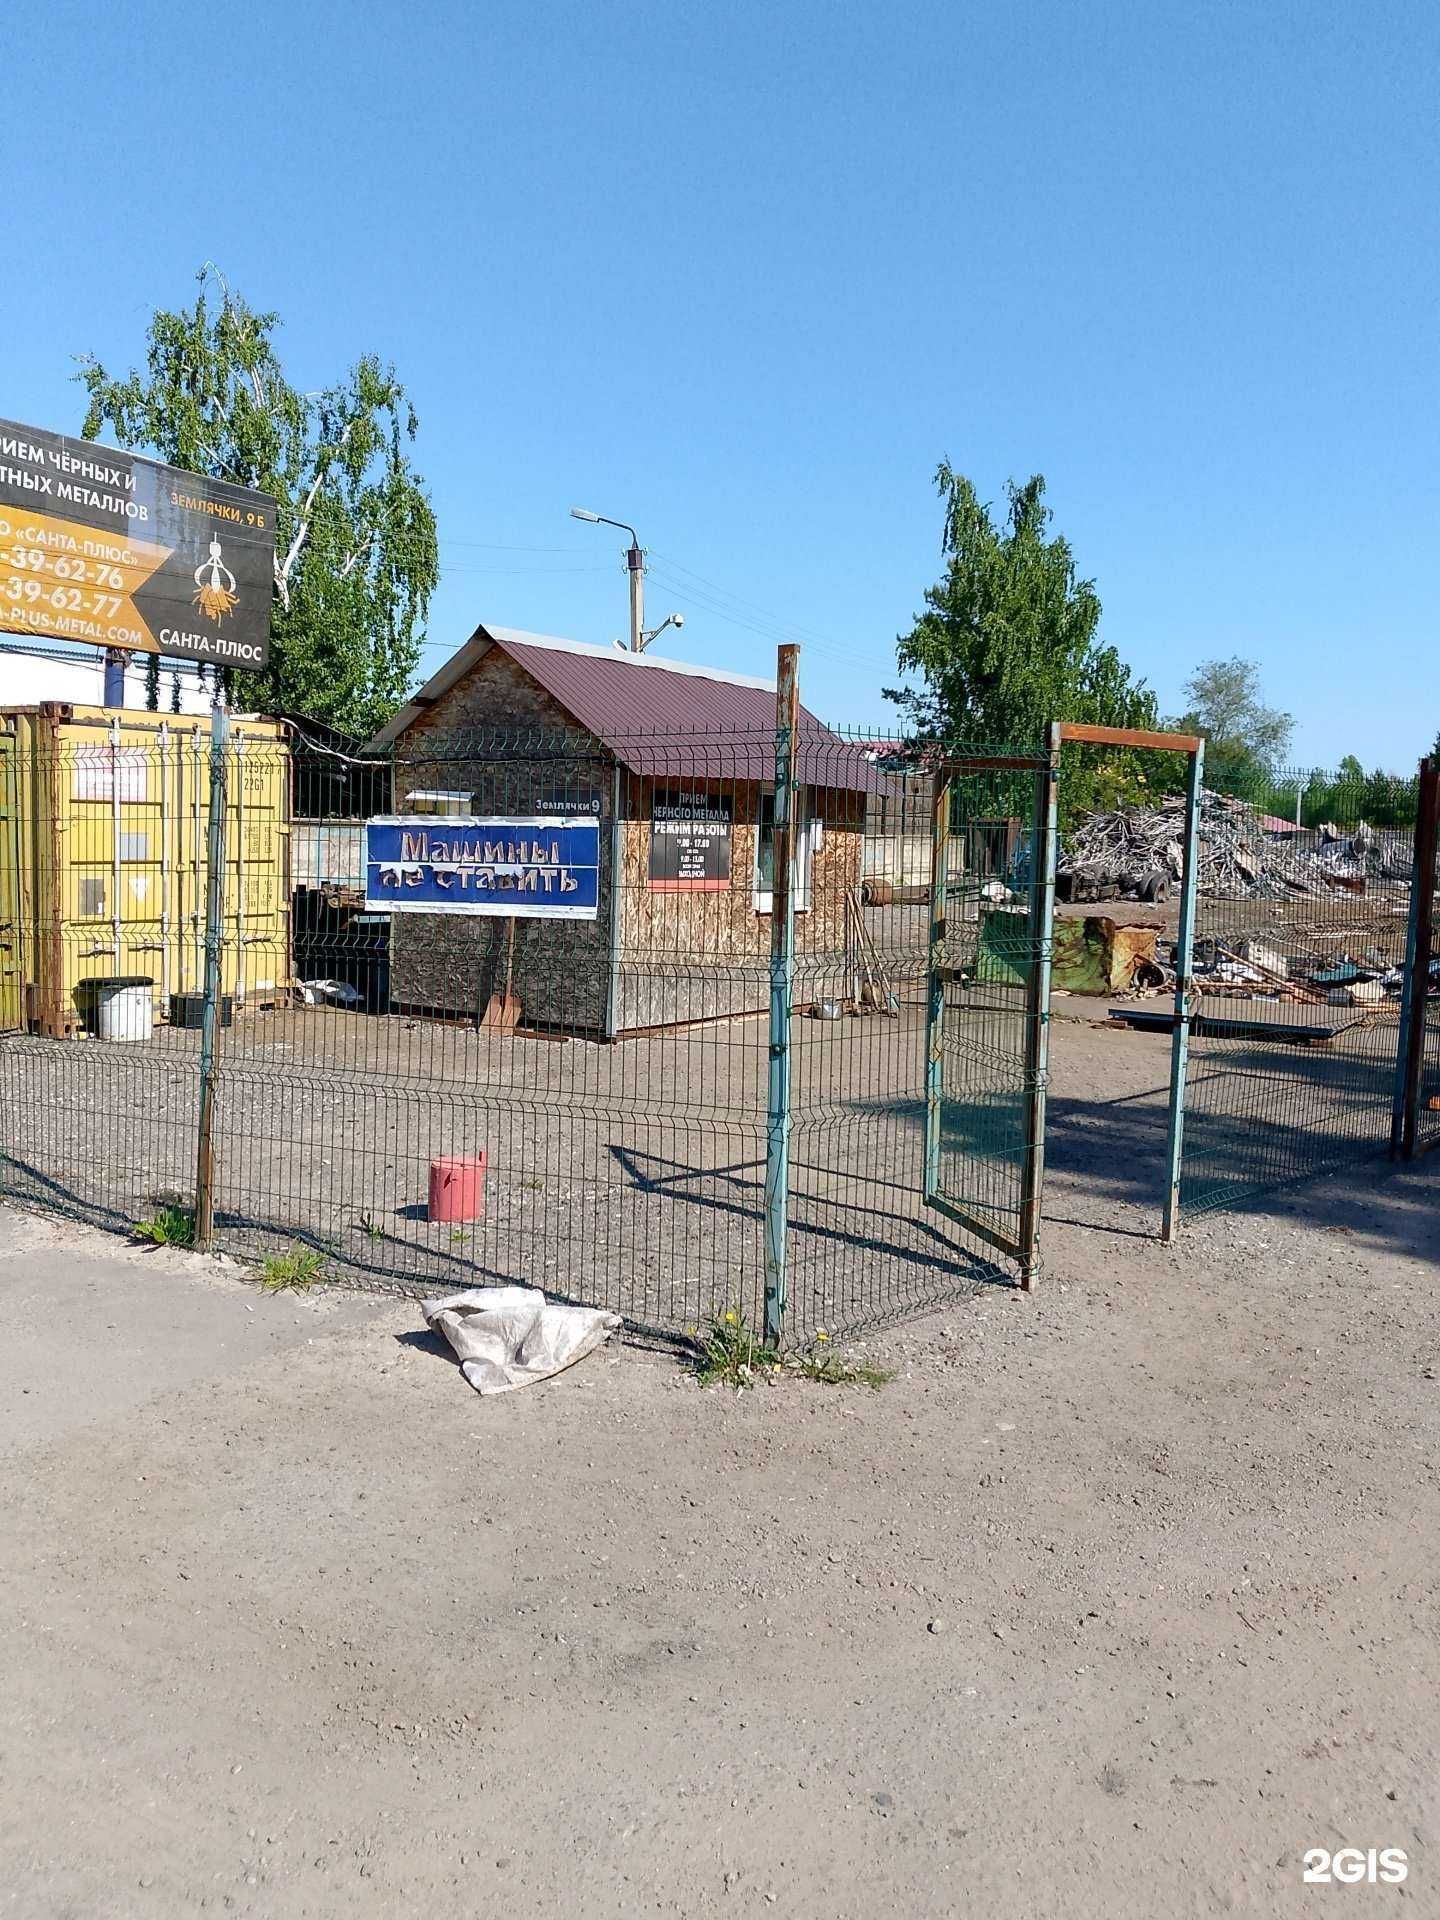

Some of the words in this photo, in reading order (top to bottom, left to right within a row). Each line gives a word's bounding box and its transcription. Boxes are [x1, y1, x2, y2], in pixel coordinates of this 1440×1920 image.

[0, 436, 45, 465] ИЕМ
[49, 451, 121, 487] ЧЁРНЫХ
[125, 473, 137, 492] И
[57, 482, 149, 521] МЕТАЛЛОВ
[170, 492, 244, 526] ЗЕМЛЯЧКИ,
[246, 513, 255, 526] 9
[257, 514, 265, 527] Б
[16, 527, 138, 566] «САНТА-ПЛЮС»
[159, 629, 263, 662] САНТА-ПЛЮС
[535, 799, 590, 811] Землячки
[592, 799, 600, 812] 9
[654, 822, 691, 834] РЕЖИМ
[401, 832, 560, 864] Машины
